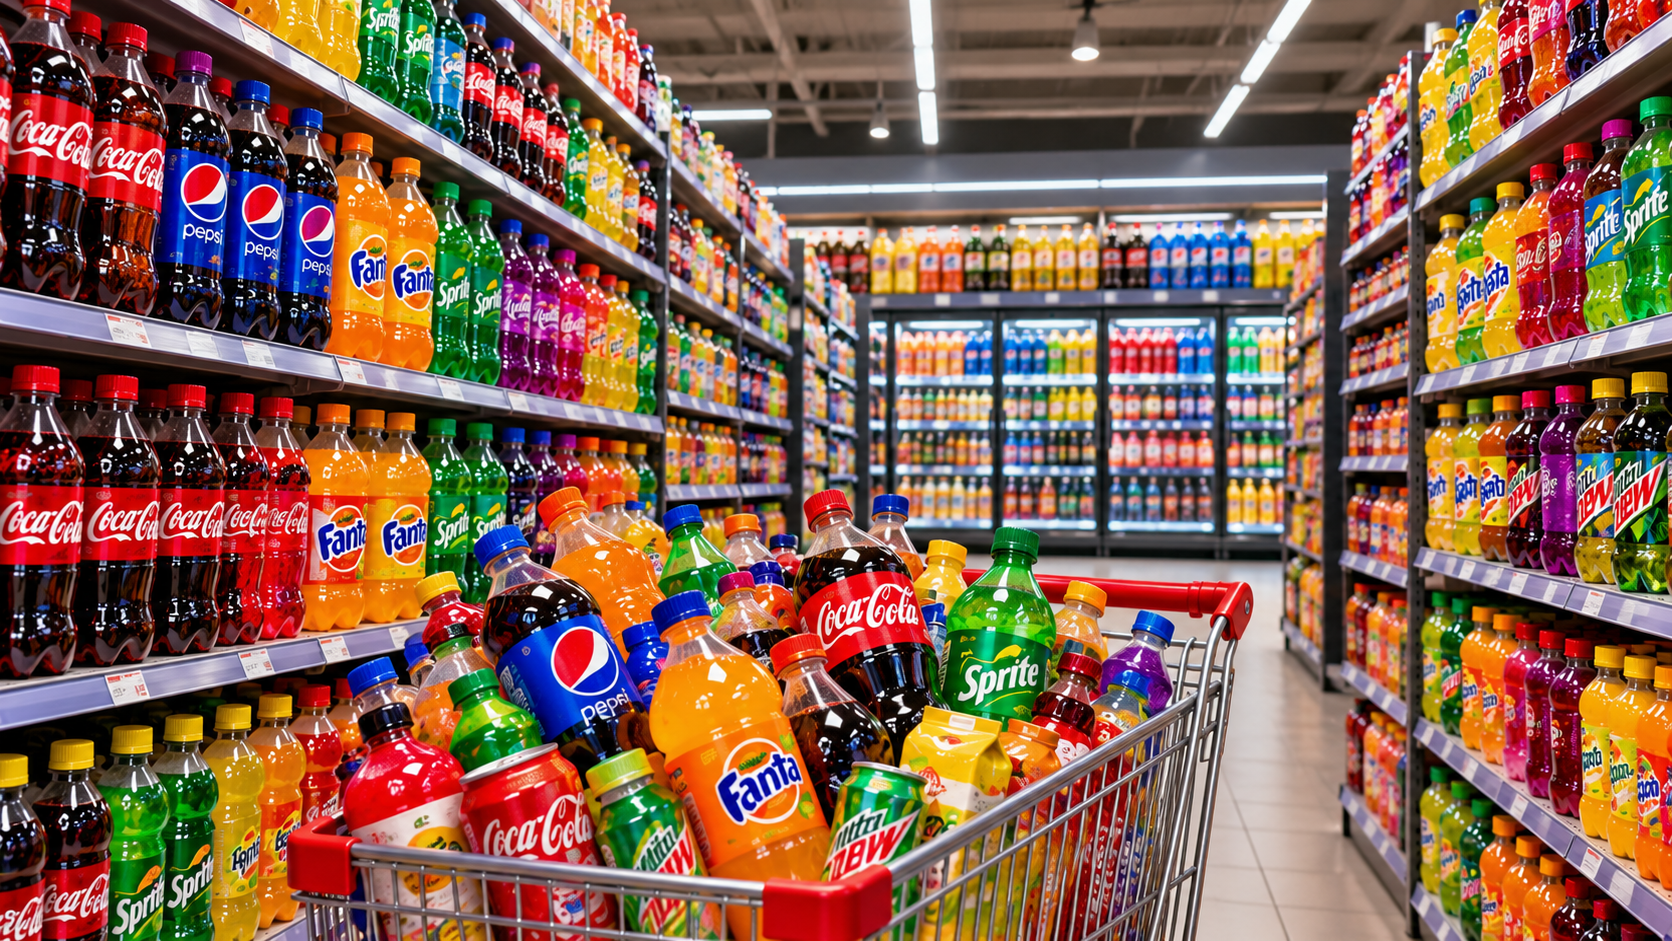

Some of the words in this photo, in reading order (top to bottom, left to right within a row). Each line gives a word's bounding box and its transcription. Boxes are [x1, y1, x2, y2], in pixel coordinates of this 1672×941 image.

[183, 223, 224, 246] pepsi
[1624, 182, 1669, 247] Sprite
[436, 276, 470, 310] Sprit
[816, 583, 919, 651] Coca-Cola
[580, 687, 630, 727] pepsi
[957, 655, 1039, 706] Sprite
[716, 752, 802, 824] Fanta
[483, 791, 593, 857] Coca-Cola
